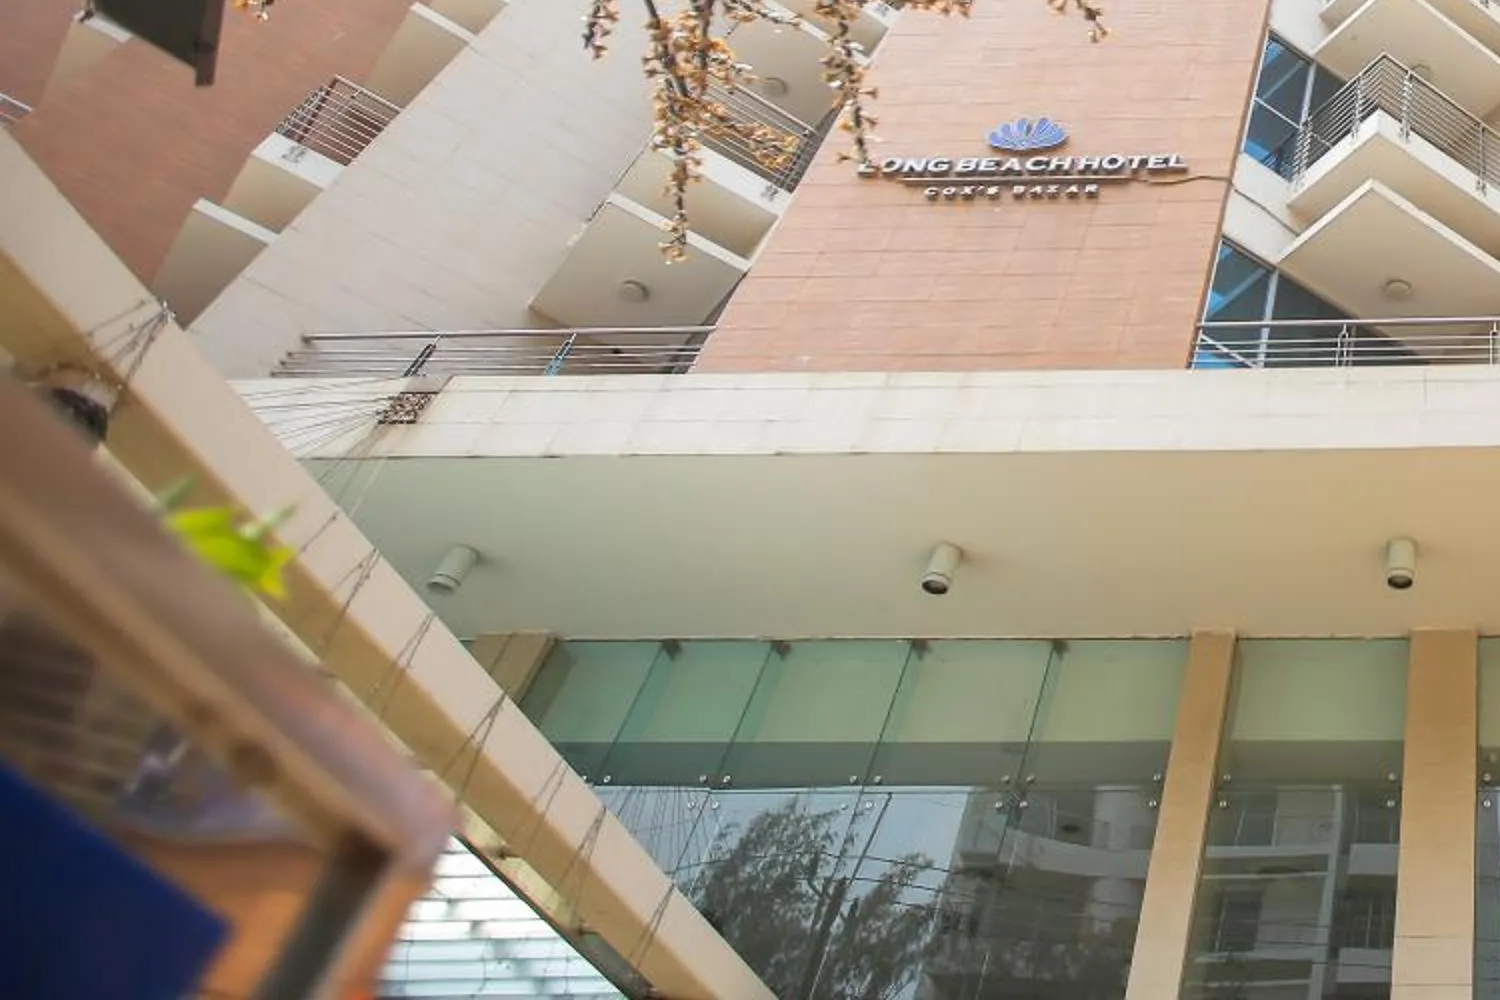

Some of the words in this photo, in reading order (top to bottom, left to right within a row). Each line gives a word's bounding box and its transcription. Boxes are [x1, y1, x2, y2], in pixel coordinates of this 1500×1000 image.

[858, 154, 950, 175] LONG
[955, 153, 1074, 173] BEACH
[1076, 152, 1186, 172] HOTEL
